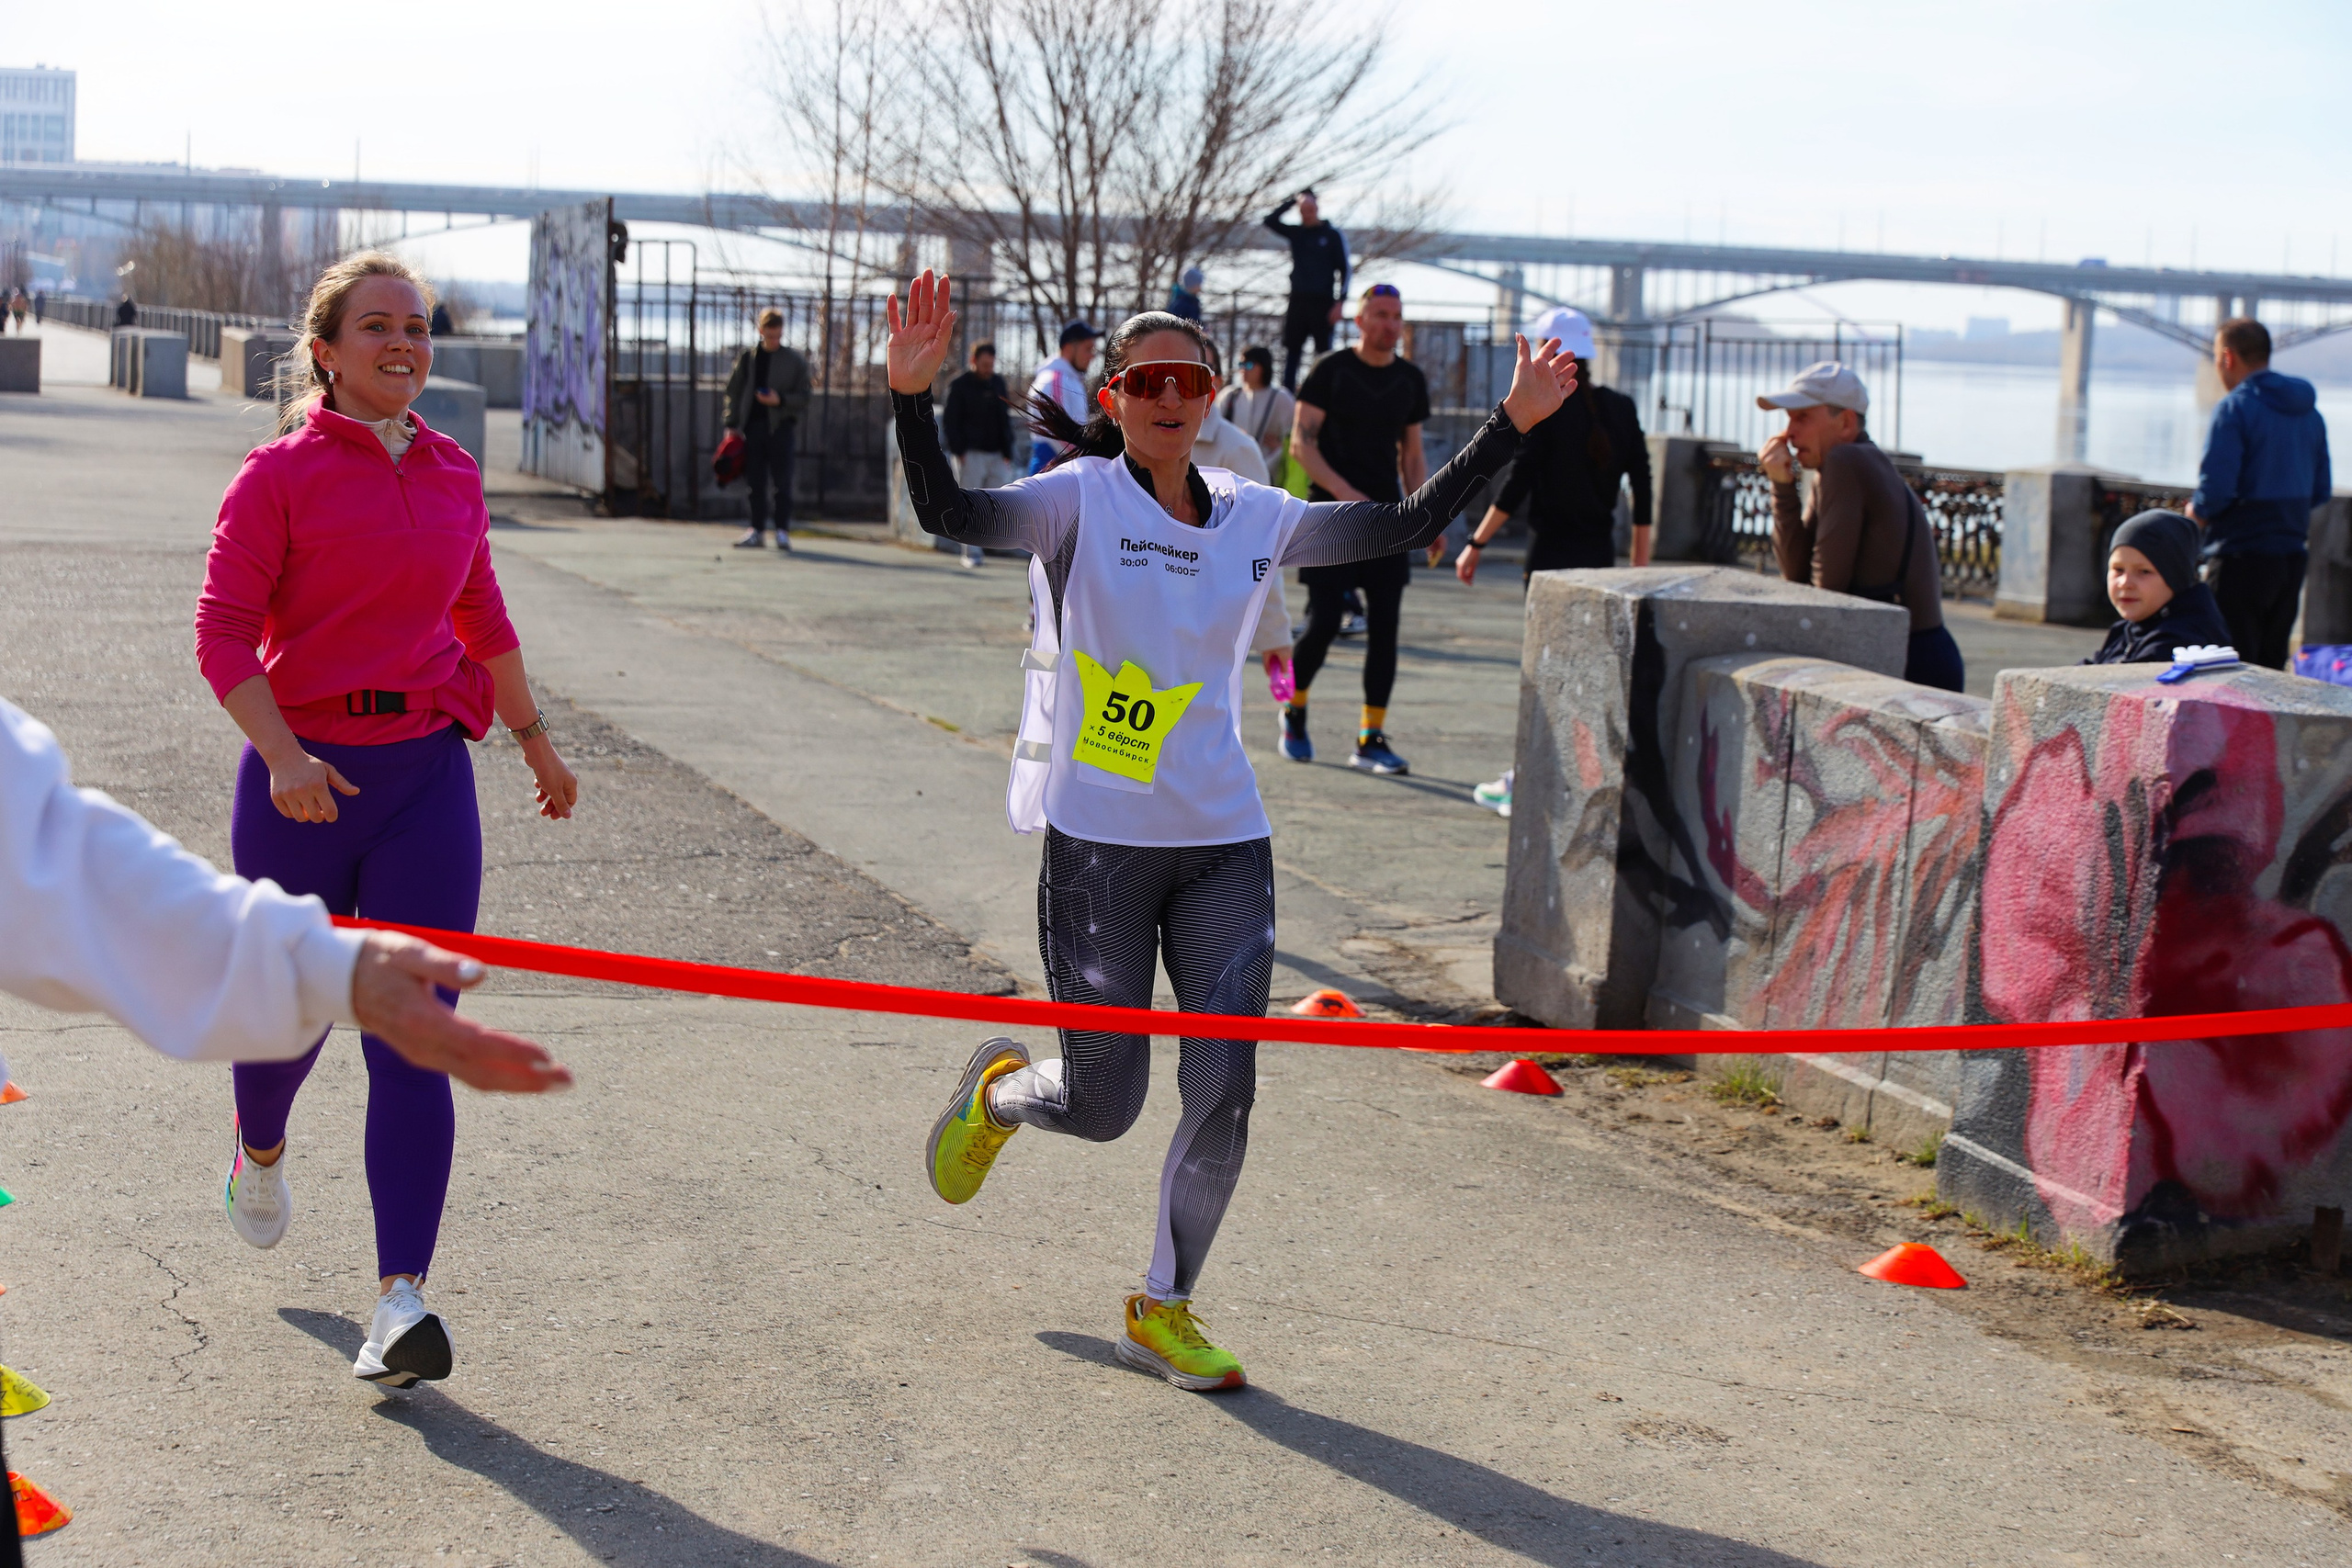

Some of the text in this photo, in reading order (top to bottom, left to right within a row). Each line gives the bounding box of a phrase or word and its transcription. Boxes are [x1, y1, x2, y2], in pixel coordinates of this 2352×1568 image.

[1120, 537, 1199, 563] Пейсмейкер
[1120, 558, 1148, 567] 30:00
[1165, 563, 1189, 575] 06:00
[1102, 691, 1155, 731] 50
[1083, 736, 1149, 763] Новосибирск
[1097, 726, 1106, 736] 5
[1107, 731, 1150, 750] вёрст
